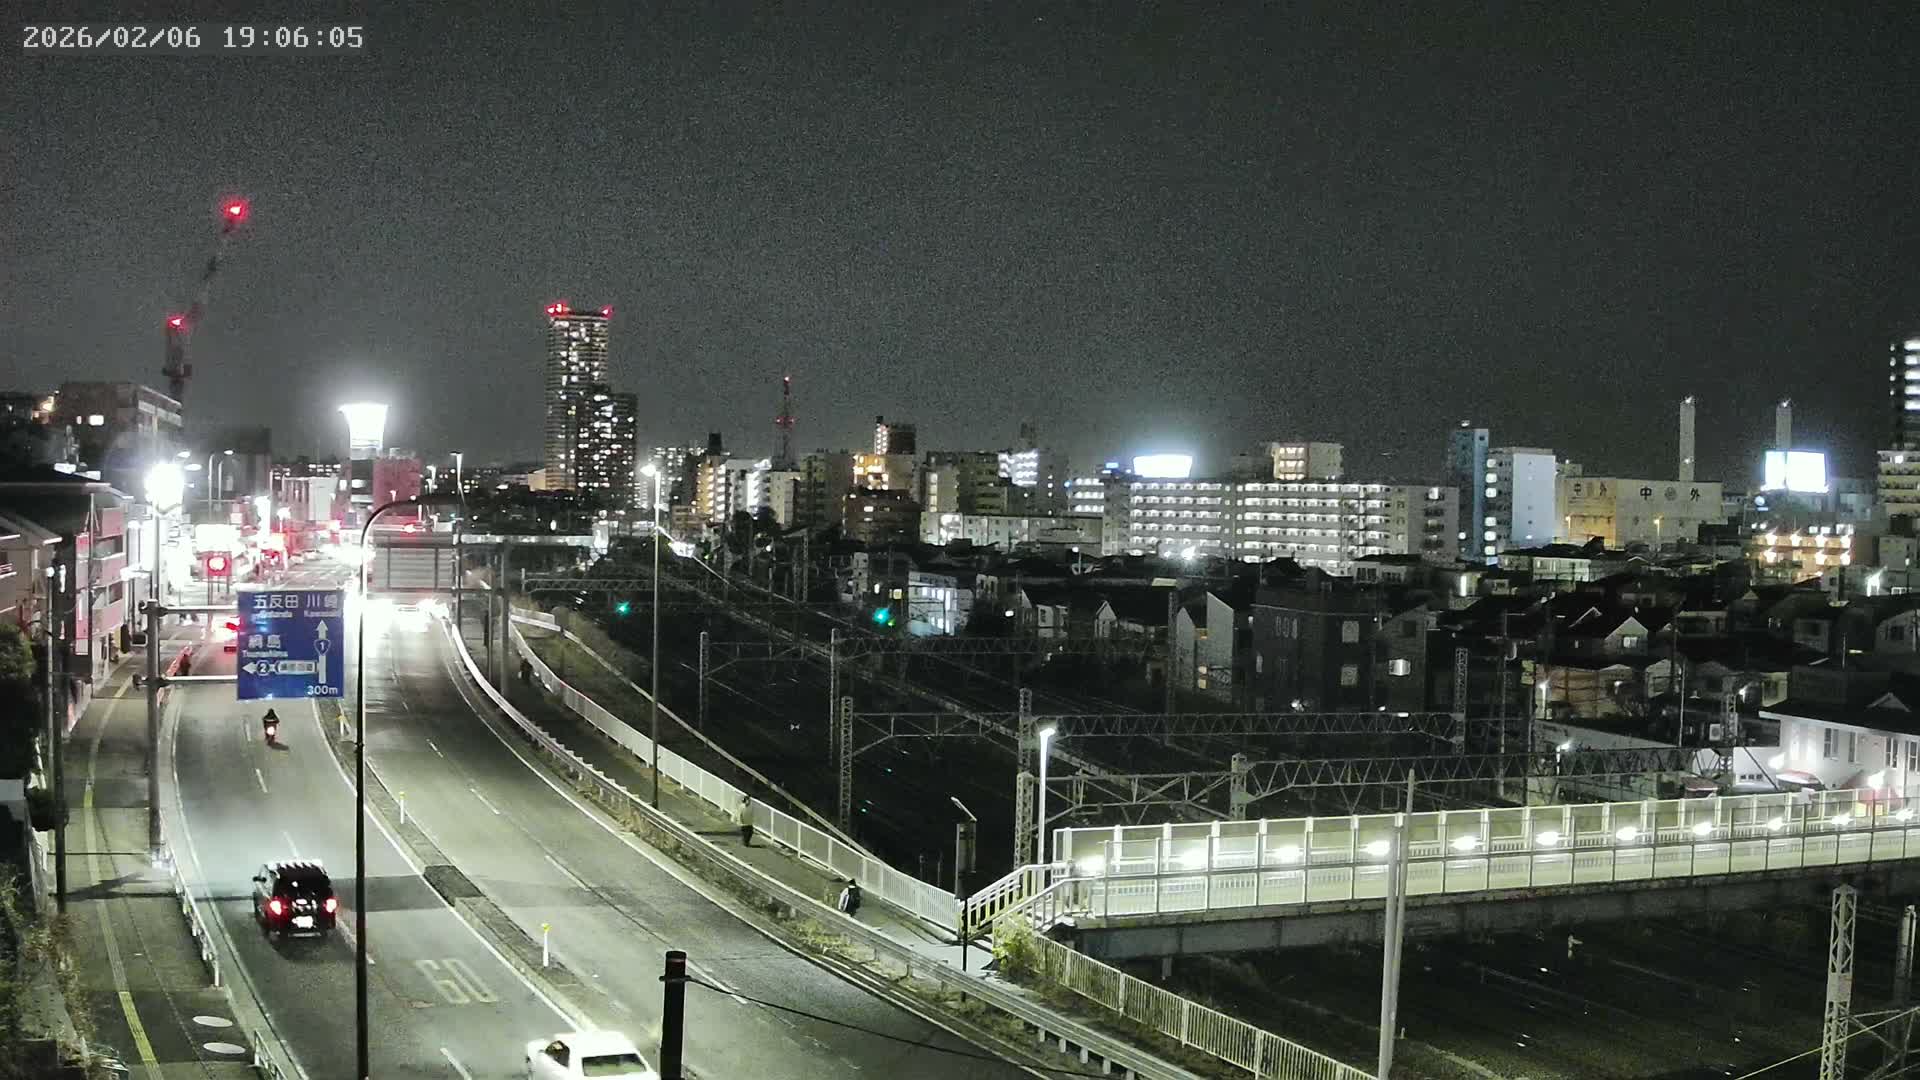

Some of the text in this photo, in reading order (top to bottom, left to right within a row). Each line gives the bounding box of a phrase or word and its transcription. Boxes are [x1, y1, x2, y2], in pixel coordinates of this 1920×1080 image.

[253, 594, 299, 609] 五反田
[259, 663, 267, 673] 2
[306, 685, 339, 695] 300m
